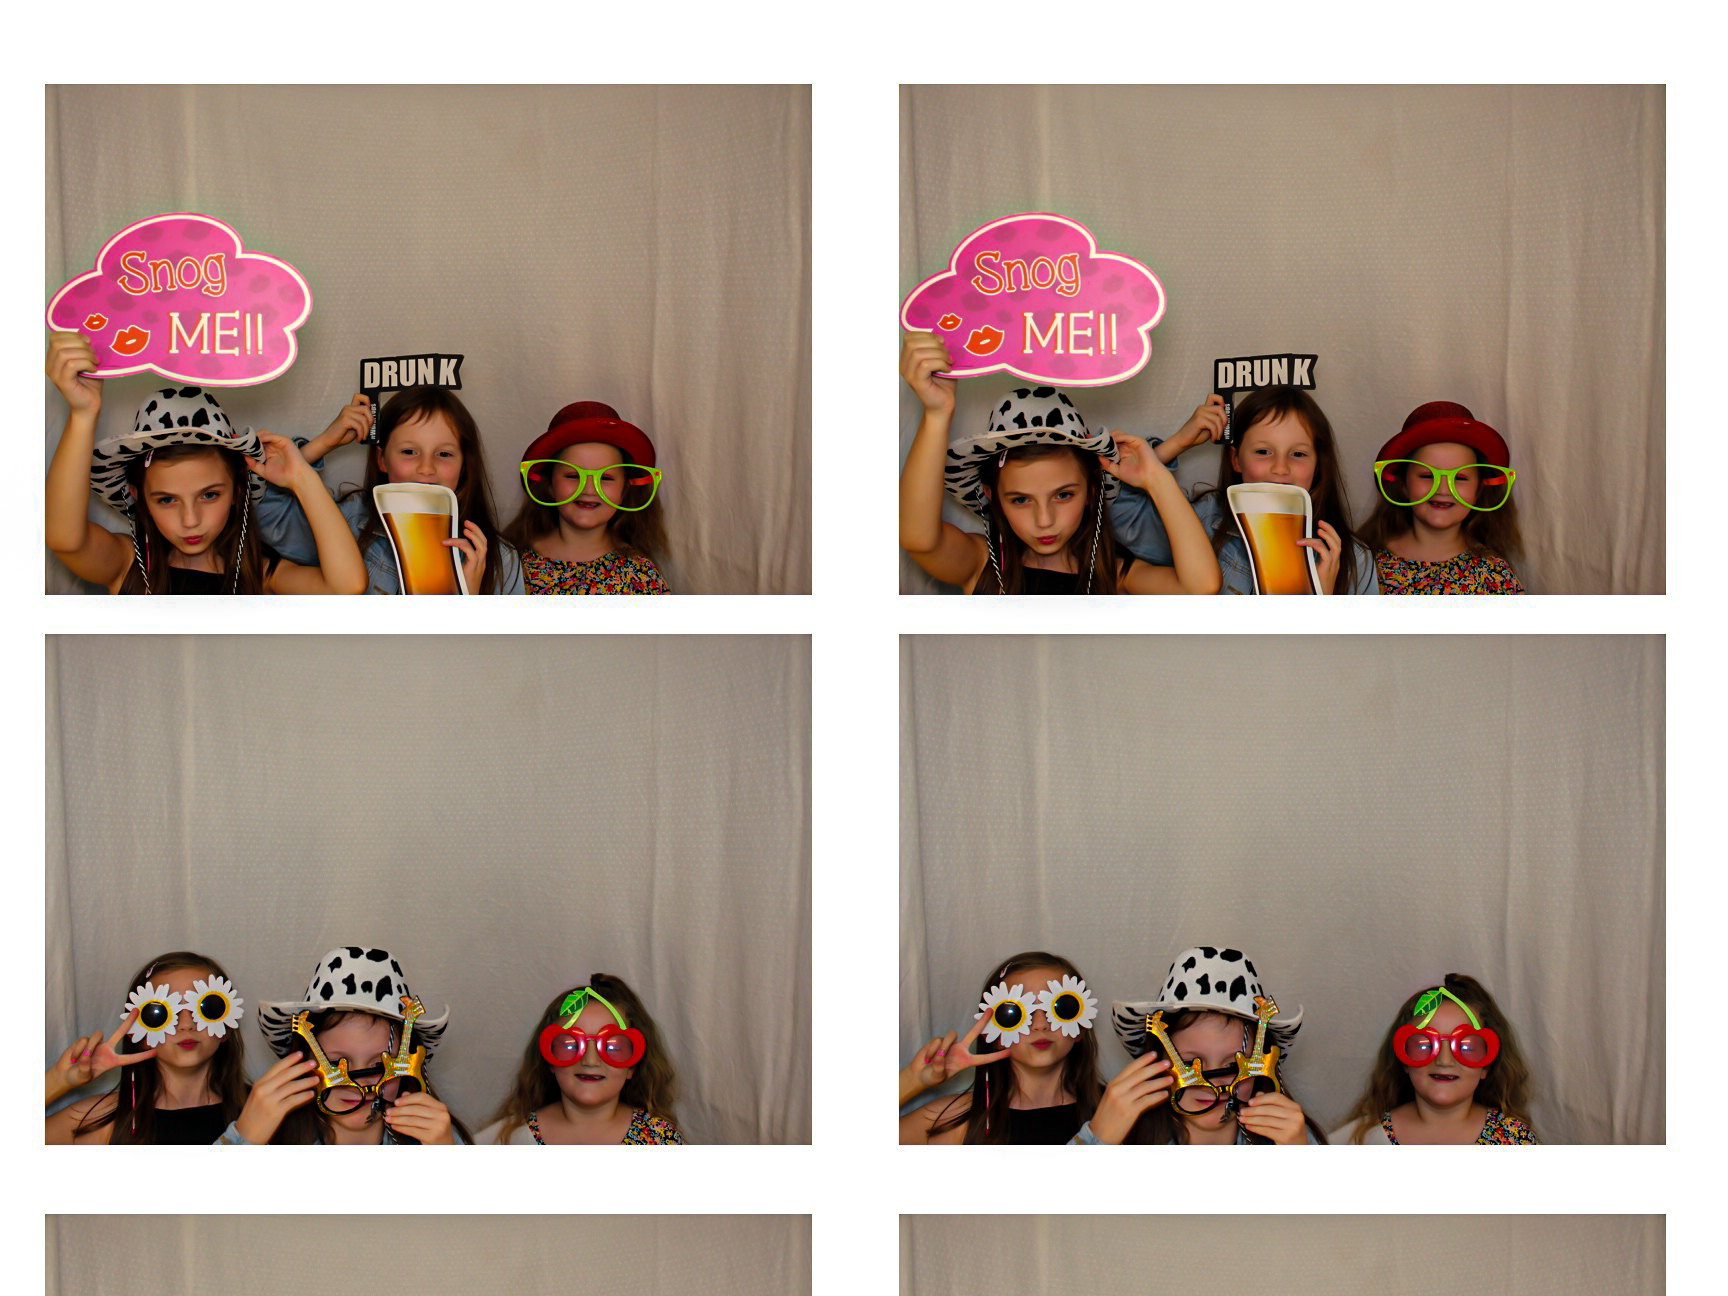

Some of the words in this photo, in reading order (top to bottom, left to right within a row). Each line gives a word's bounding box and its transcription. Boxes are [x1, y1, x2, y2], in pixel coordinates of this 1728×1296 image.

[117, 250, 227, 298] Snog
[971, 250, 1081, 298] Snog
[168, 310, 263, 357] ME!!
[1022, 310, 1117, 357] ME!!
[363, 357, 458, 389] DRUNK
[1217, 357, 1312, 389] DRUNK
